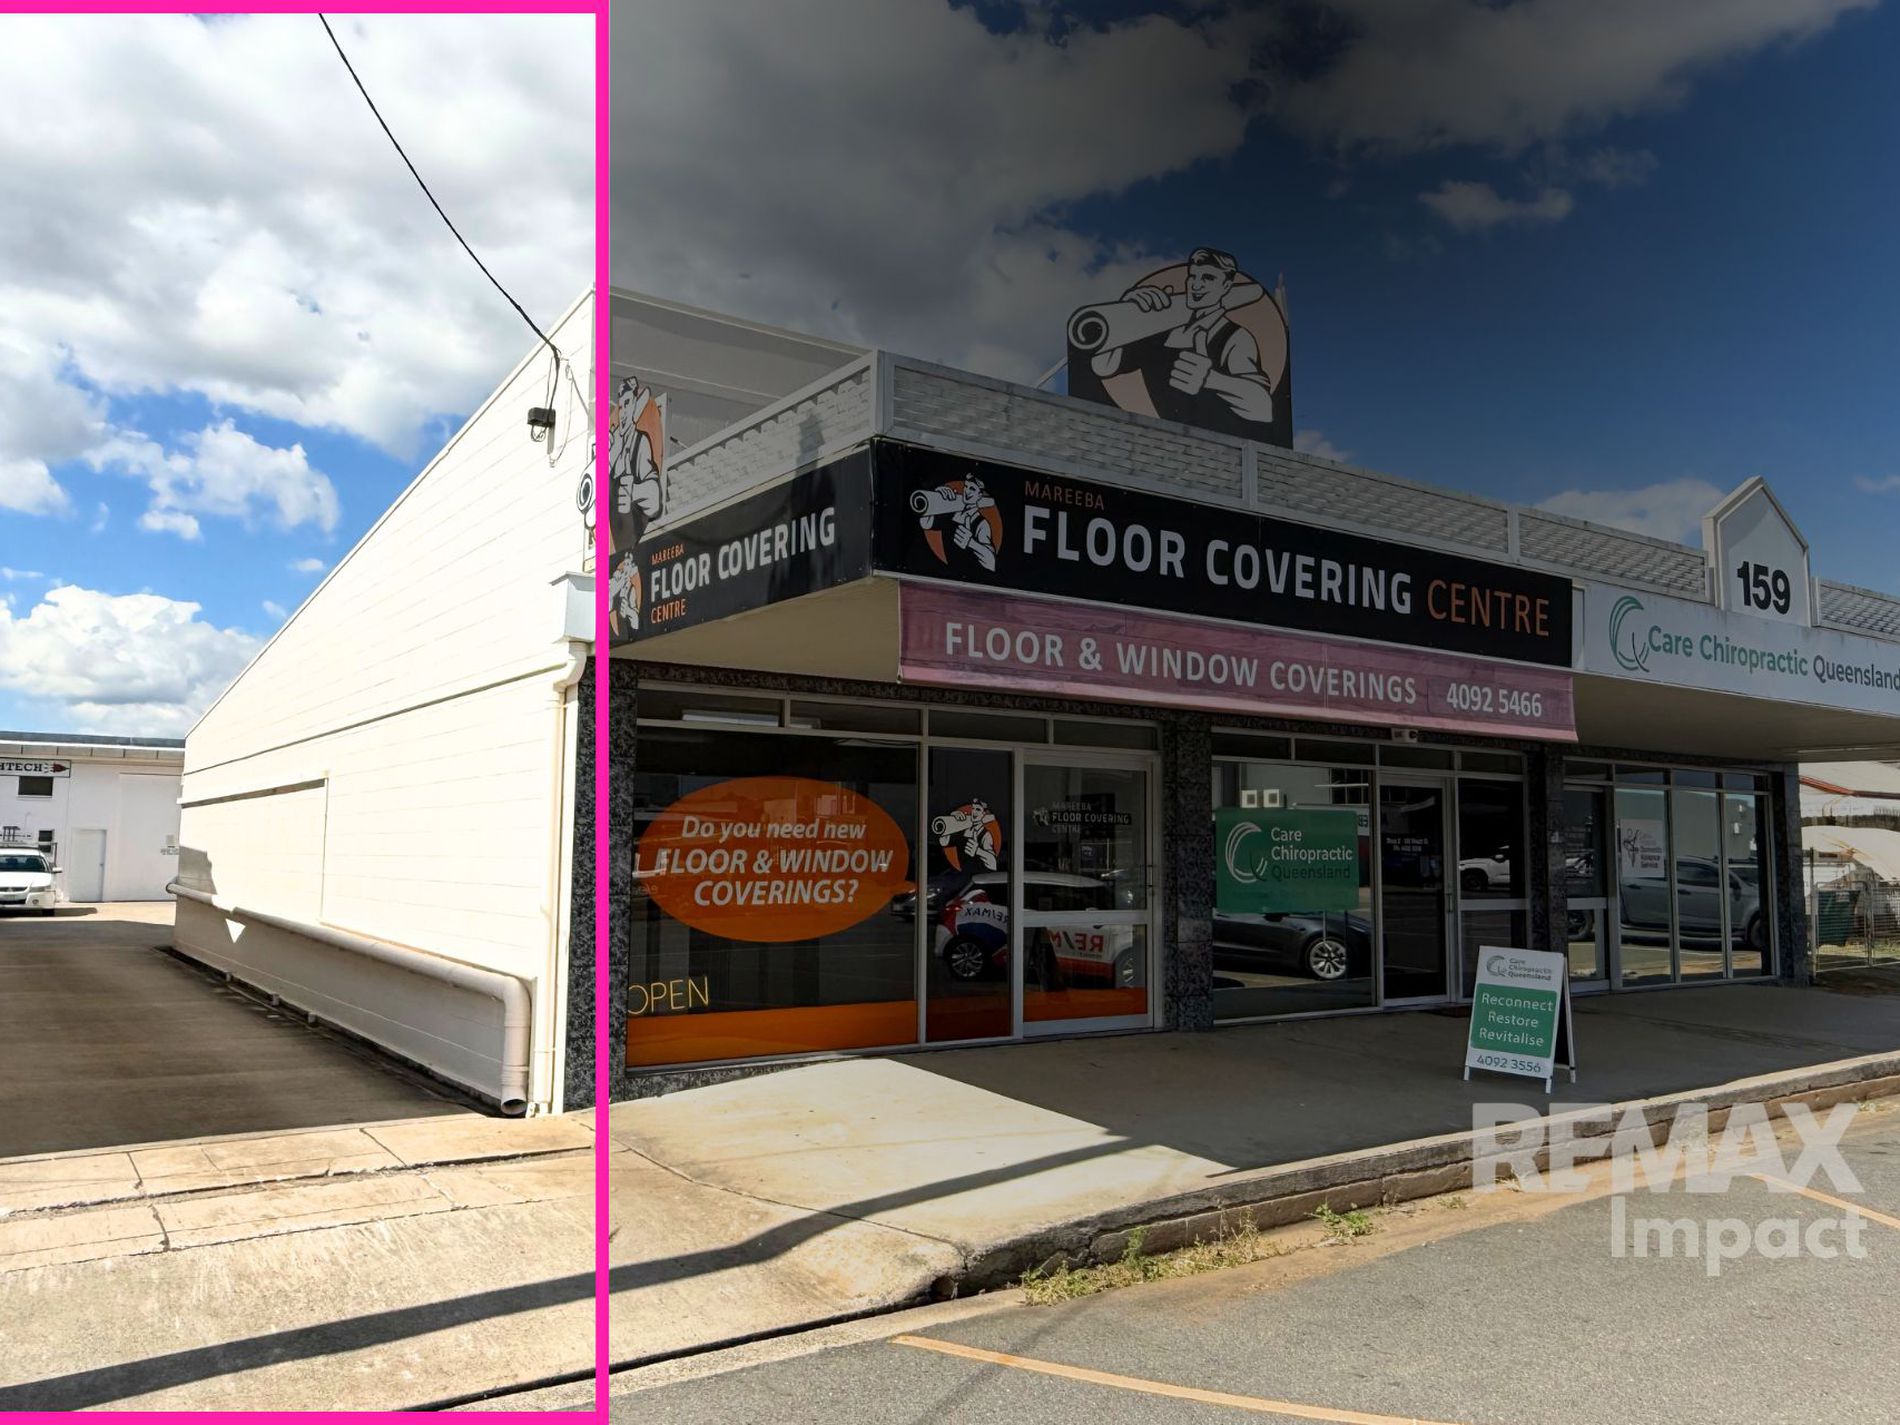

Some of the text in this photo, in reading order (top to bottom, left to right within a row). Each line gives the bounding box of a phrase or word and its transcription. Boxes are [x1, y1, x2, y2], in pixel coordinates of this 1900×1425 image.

[1025, 480, 1105, 511] MAREEBA
[651, 544, 685, 563] MAREEBA
[651, 507, 836, 603] FLOOR COVERING
[1023, 504, 1550, 636] FLOOR COVERING CENTRE
[1737, 561, 1791, 615] 159
[651, 599, 686, 624] CENTRE
[946, 622, 1542, 717] FLOOR & WINDOW COVERINGS 4092 5466
[1648, 625, 1900, 691] Care Chiropractic Queensland
[682, 816, 866, 844] Do you need new
[1051, 812, 1130, 824] FLOOR COVERING
[1271, 827, 1303, 843] Care
[655, 849, 894, 874] FLOOR & WINDOW
[1271, 845, 1353, 864] Chiropractic
[1271, 865, 1351, 881] Queensland
[694, 879, 859, 906] COVERINGS?
[626, 976, 710, 1015] OPEN
[1482, 992, 1554, 1012] Reconnect
[1488, 1010, 1539, 1028] Restore
[1479, 1027, 1545, 1047] Revitalise
[1476, 1054, 1542, 1073] 4092 3556
